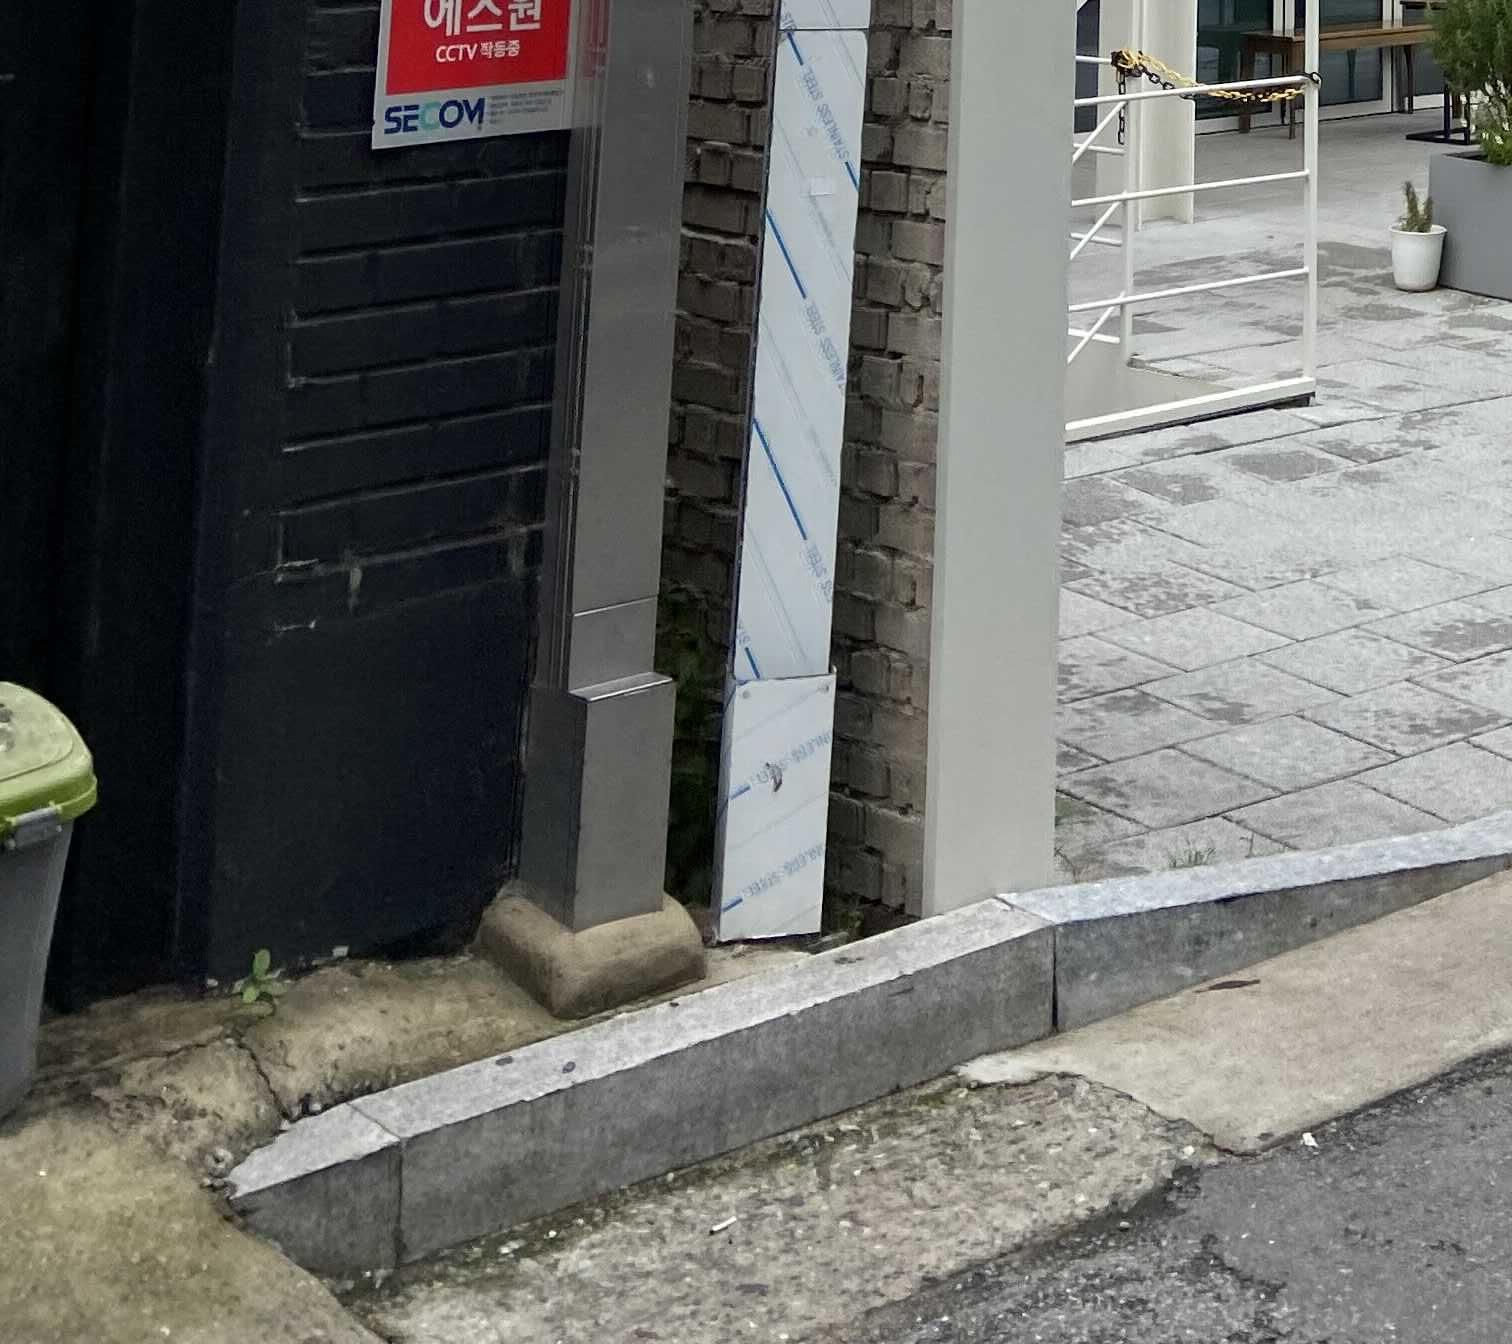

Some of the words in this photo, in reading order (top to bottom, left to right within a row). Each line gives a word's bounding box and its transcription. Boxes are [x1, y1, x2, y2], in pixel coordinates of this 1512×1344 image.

[436, 43, 478, 63] CCTV
[480, 40, 521, 58] 작동중
[384, 97, 486, 134] SECOM
